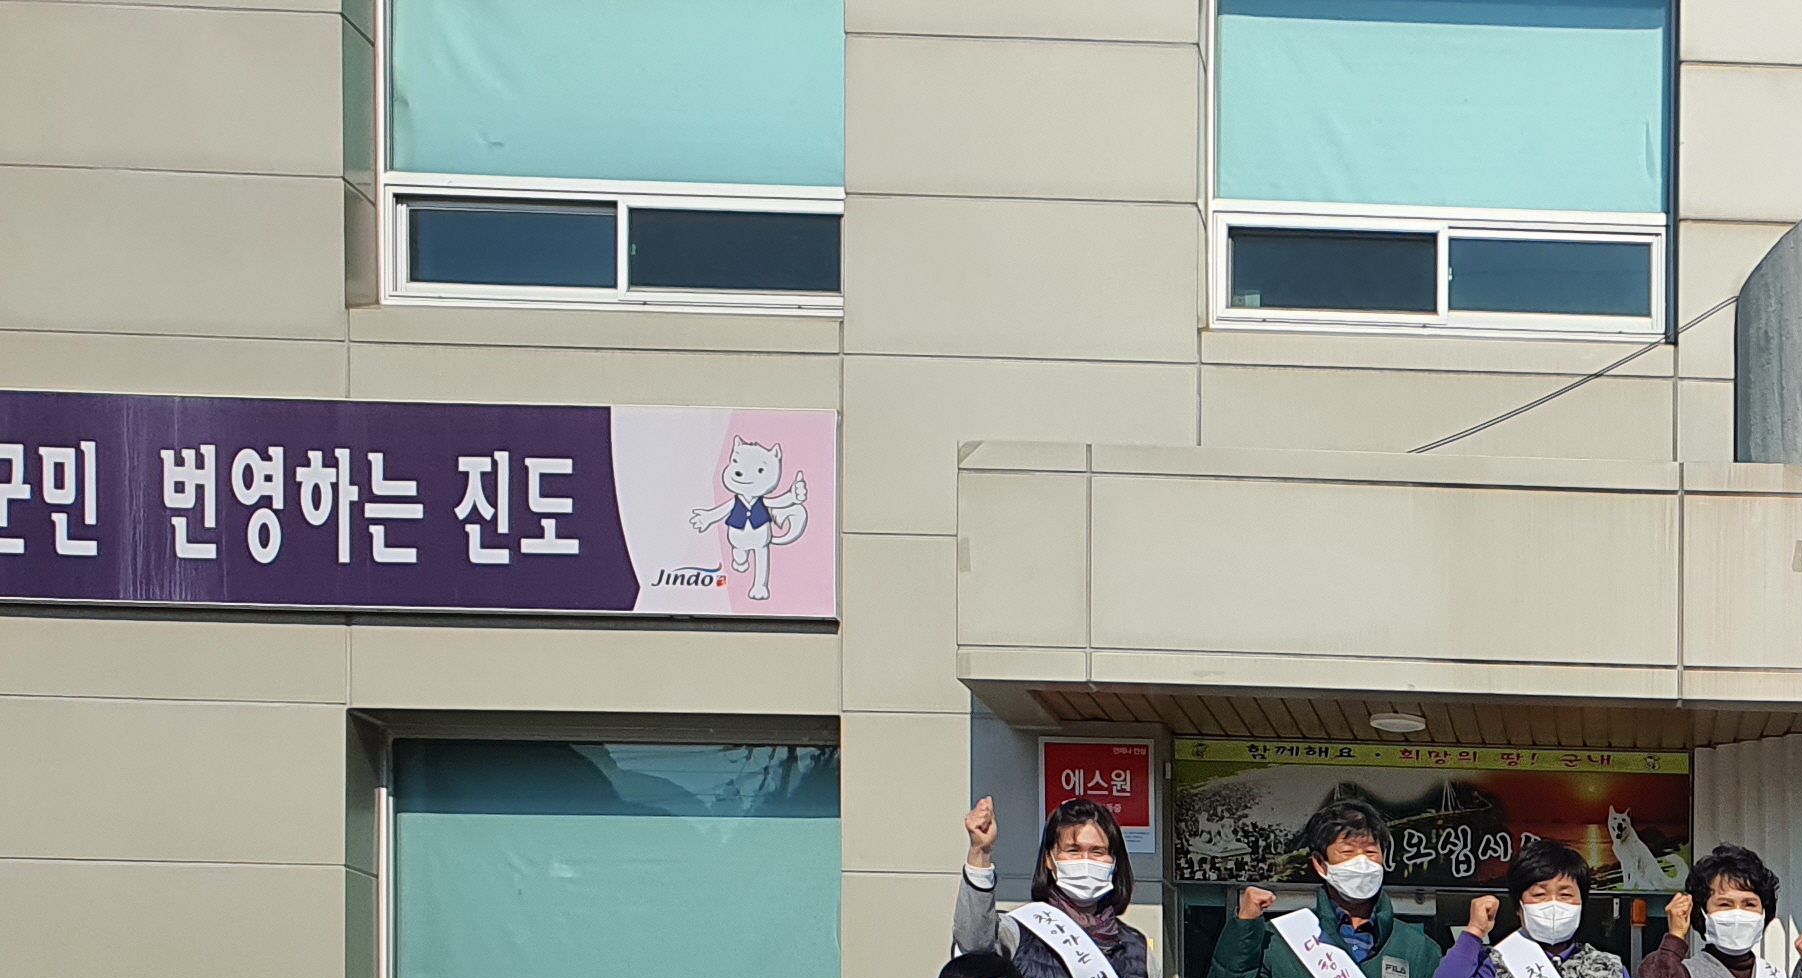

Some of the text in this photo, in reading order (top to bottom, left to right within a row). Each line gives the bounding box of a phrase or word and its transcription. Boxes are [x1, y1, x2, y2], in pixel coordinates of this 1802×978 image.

[160, 444, 424, 564] 번영하는
[454, 449, 580, 565] 진도
[651, 569, 714, 587] Jindo
[1247, 744, 1355, 760] 함께해요
[1400, 748, 1477, 765] 희망의
[1560, 754, 1612, 768] 군내
[1061, 768, 1132, 797] 에스원
[1032, 910, 1092, 965] 찾아가는
[1384, 963, 1407, 975] FILA
